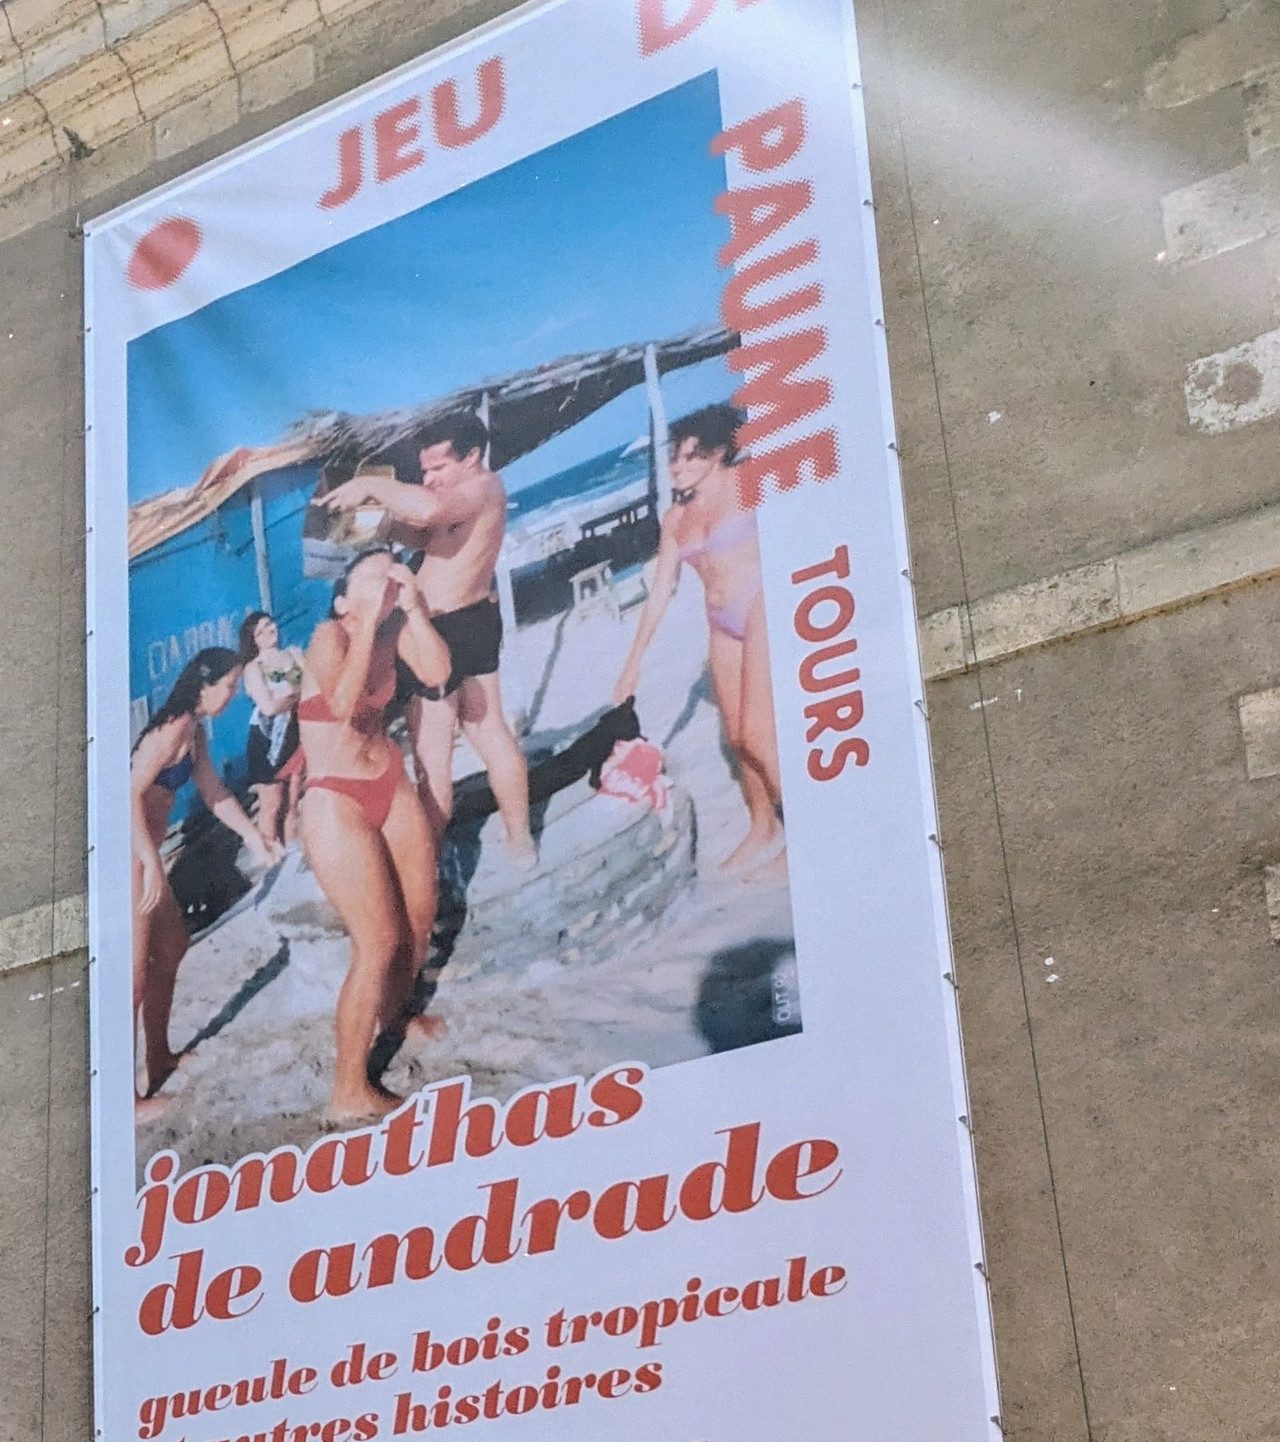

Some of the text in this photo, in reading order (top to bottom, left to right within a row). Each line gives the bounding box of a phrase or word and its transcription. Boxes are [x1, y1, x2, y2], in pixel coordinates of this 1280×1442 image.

[316, 0, 764, 211] JEU D
[709, 95, 842, 512] PAUME
[790, 545, 870, 783] TOURS
[124, 1066, 645, 1267] jonathas
[139, 1121, 844, 1336] de andrade
[139, 1256, 848, 1439] gueule de bois tropicale
[393, 1361, 663, 1435] histoires
